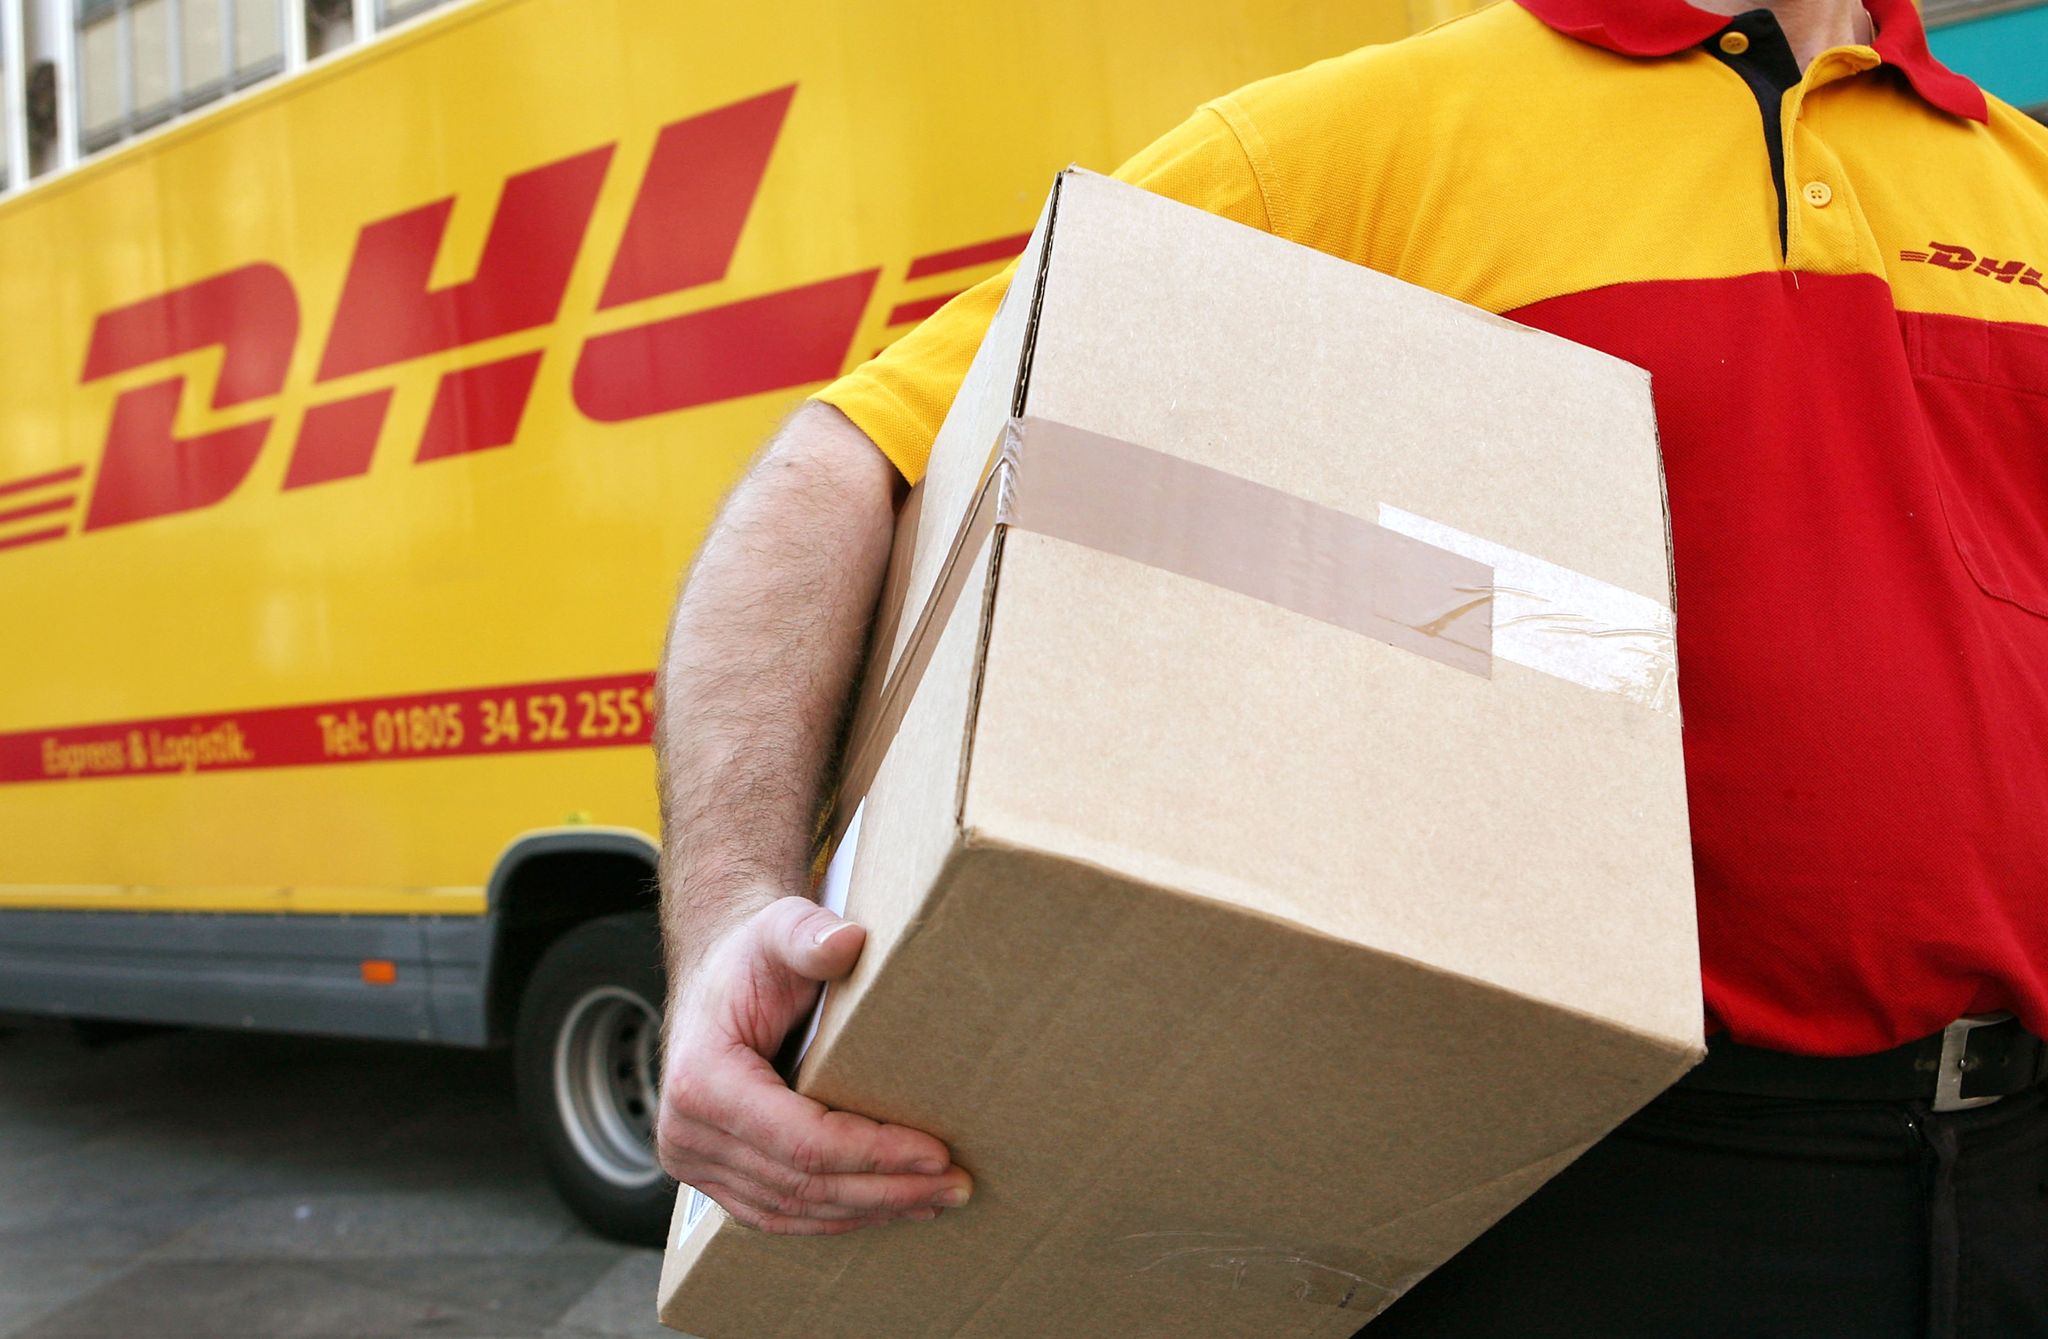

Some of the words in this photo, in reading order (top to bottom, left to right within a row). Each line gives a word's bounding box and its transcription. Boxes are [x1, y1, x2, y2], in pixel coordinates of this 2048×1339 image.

[79, 81, 884, 534] DHL
[1927, 240, 2048, 296] DHL
[42, 737, 124, 778] Express
[127, 730, 147, 768] &
[373, 702, 464, 754] 01805
[479, 698, 520, 746] 34
[527, 693, 570, 743] 52
